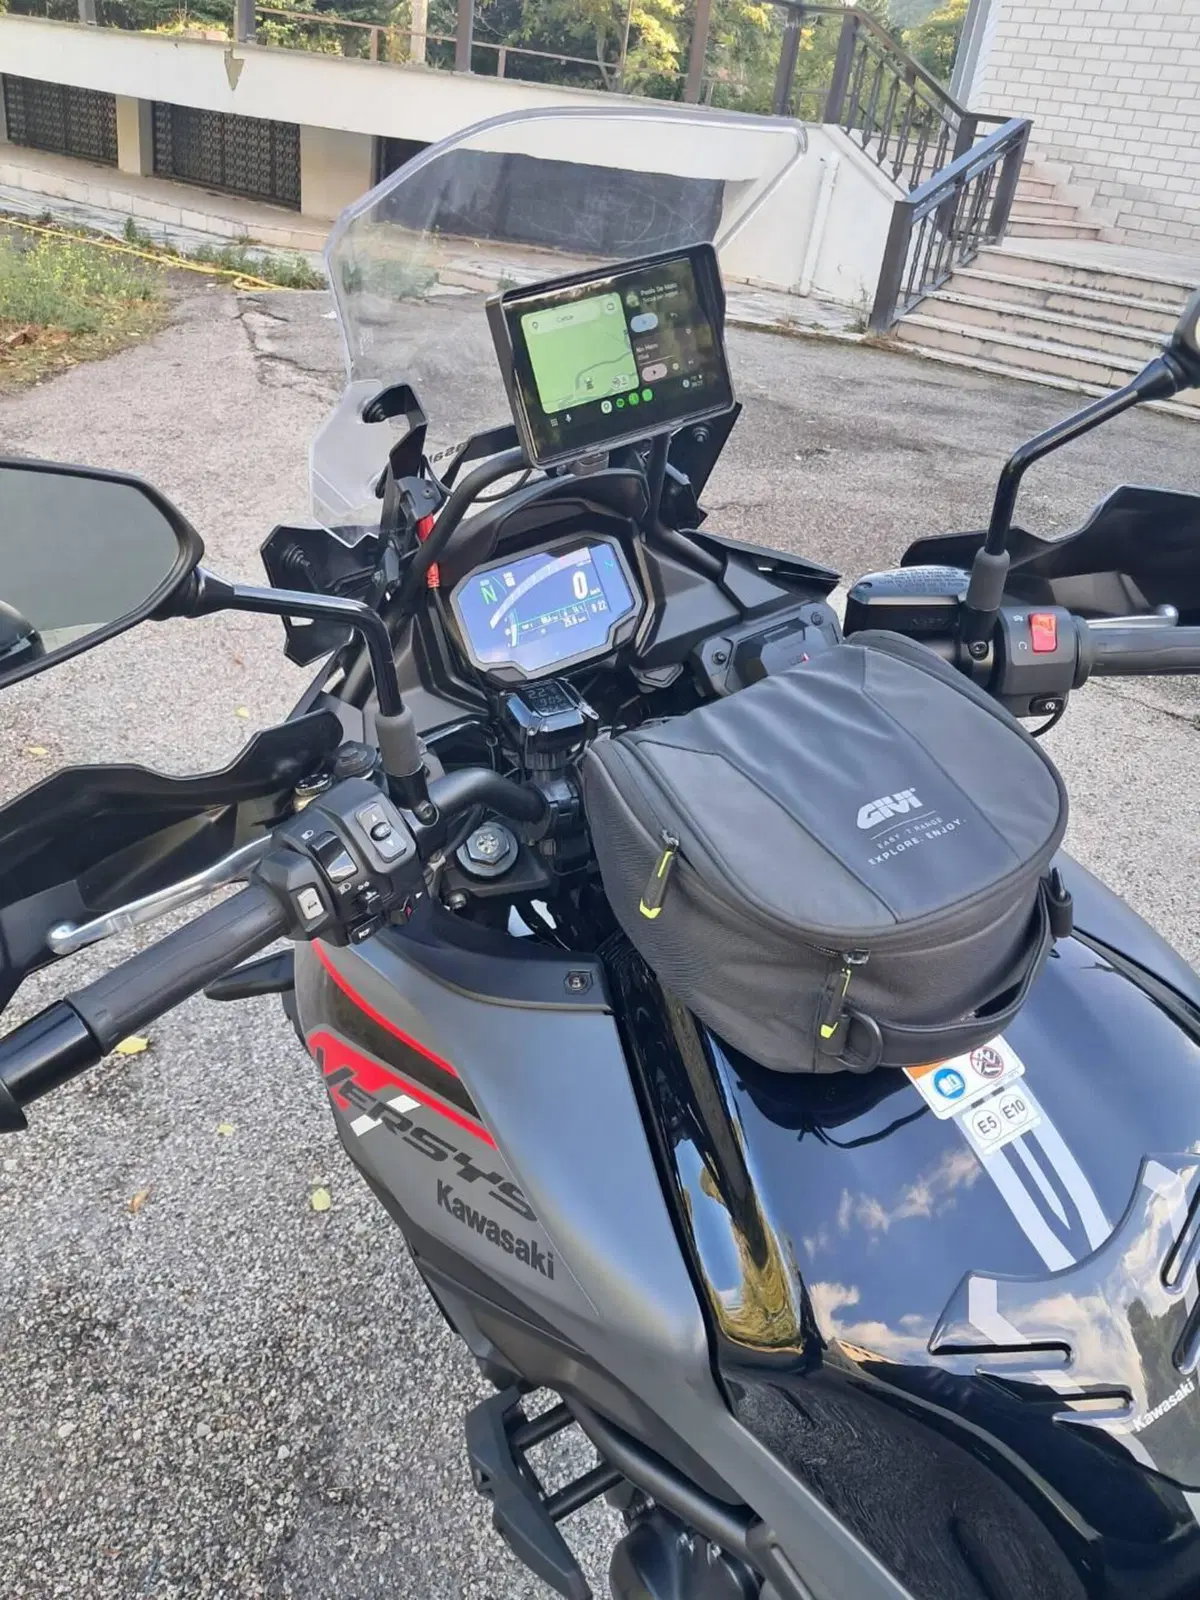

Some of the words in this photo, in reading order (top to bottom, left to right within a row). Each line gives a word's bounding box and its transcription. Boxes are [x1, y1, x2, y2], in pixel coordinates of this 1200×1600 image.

[481, 585, 497, 604] N
[573, 571, 589, 599] 0
[856, 788, 923, 830] GIVI
[876, 832, 901, 849] EASY
[914, 817, 944, 831] RANGE
[316, 1047, 537, 1221] VERSYS
[978, 1115, 996, 1134] E5
[1002, 1099, 1024, 1119] E10
[436, 1179, 554, 1280] Kawasaki
[1133, 1378, 1195, 1431] Kawasaki
